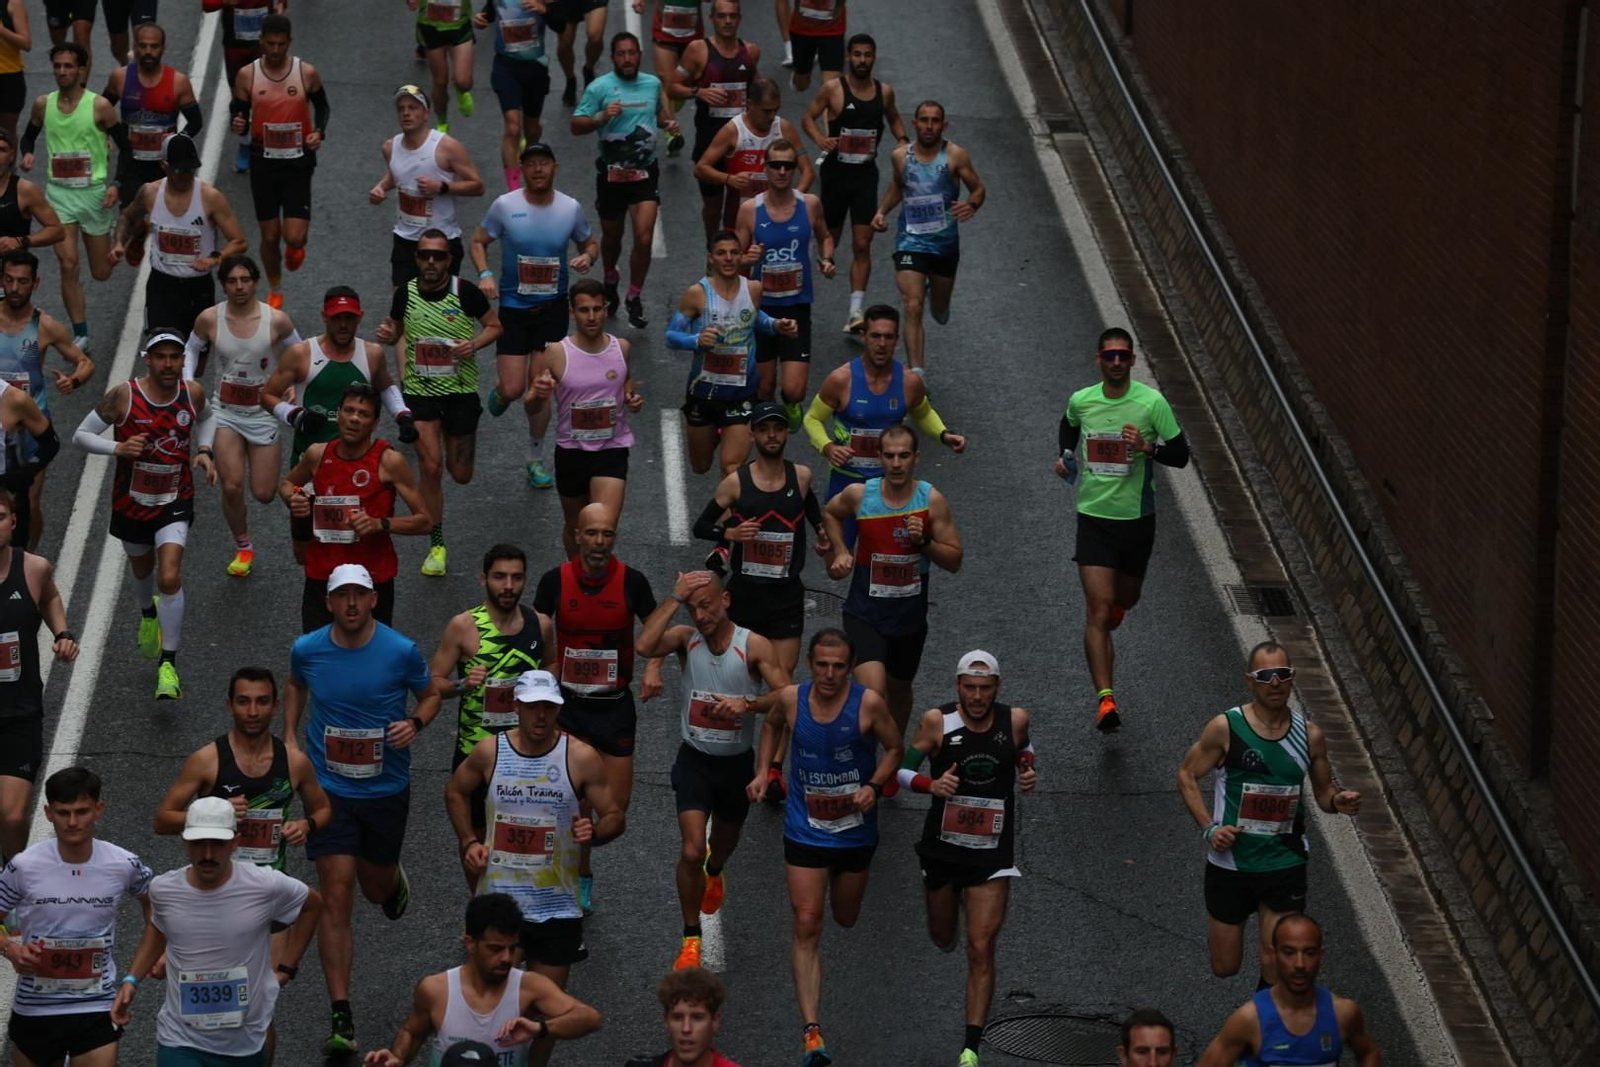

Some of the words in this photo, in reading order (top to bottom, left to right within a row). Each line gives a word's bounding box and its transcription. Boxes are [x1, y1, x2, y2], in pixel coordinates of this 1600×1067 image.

[753, 542, 785, 559] 1085
[574, 662, 601, 677] 998
[336, 741, 367, 757] 712
[496, 785, 524, 797] Falcón
[1252, 797, 1287, 815] 1080
[956, 808, 985, 827] 984
[506, 827, 537, 846] 357
[52, 952, 83, 971] 943
[190, 984, 233, 1005] 3339
